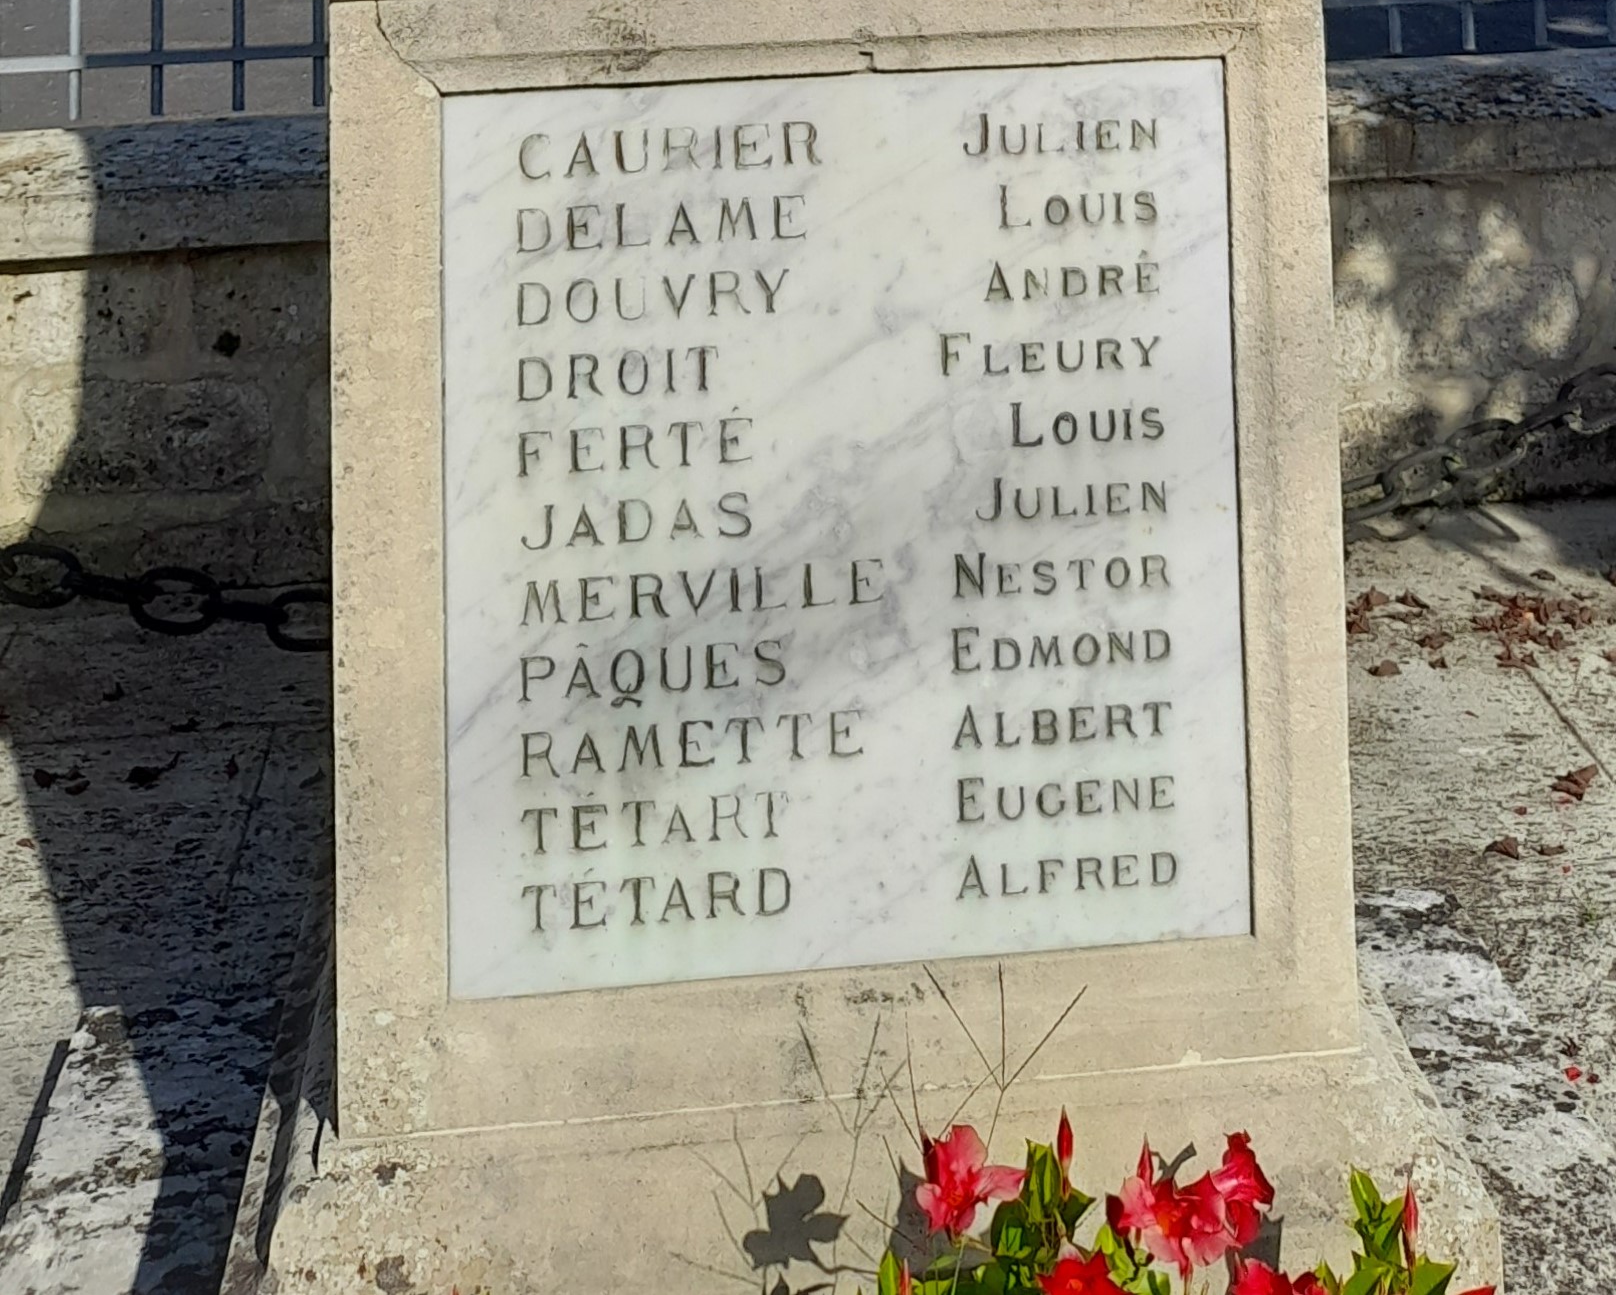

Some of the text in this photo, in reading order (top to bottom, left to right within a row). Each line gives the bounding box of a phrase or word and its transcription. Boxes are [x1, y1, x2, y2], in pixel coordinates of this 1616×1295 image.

[518, 113, 1159, 180] CAURIER JULIEN
[516, 184, 1159, 254] DELAME LOUIS
[516, 250, 1161, 327] DOUVRY ANDRÉ
[516, 332, 1161, 402] DROIT FLEURY
[516, 401, 1165, 478] FERTÉ LOUIS
[521, 476, 1168, 550] JADAS JULIEN
[519, 553, 1171, 626] MERVILLE NESTOR
[517, 626, 1172, 707] PÂQUES EDMOND
[520, 701, 1172, 777] RAMETTE ALBERT
[520, 774, 1175, 856] TÉTART EUGENE
[521, 850, 1177, 933] TÉTARD ALFRED
